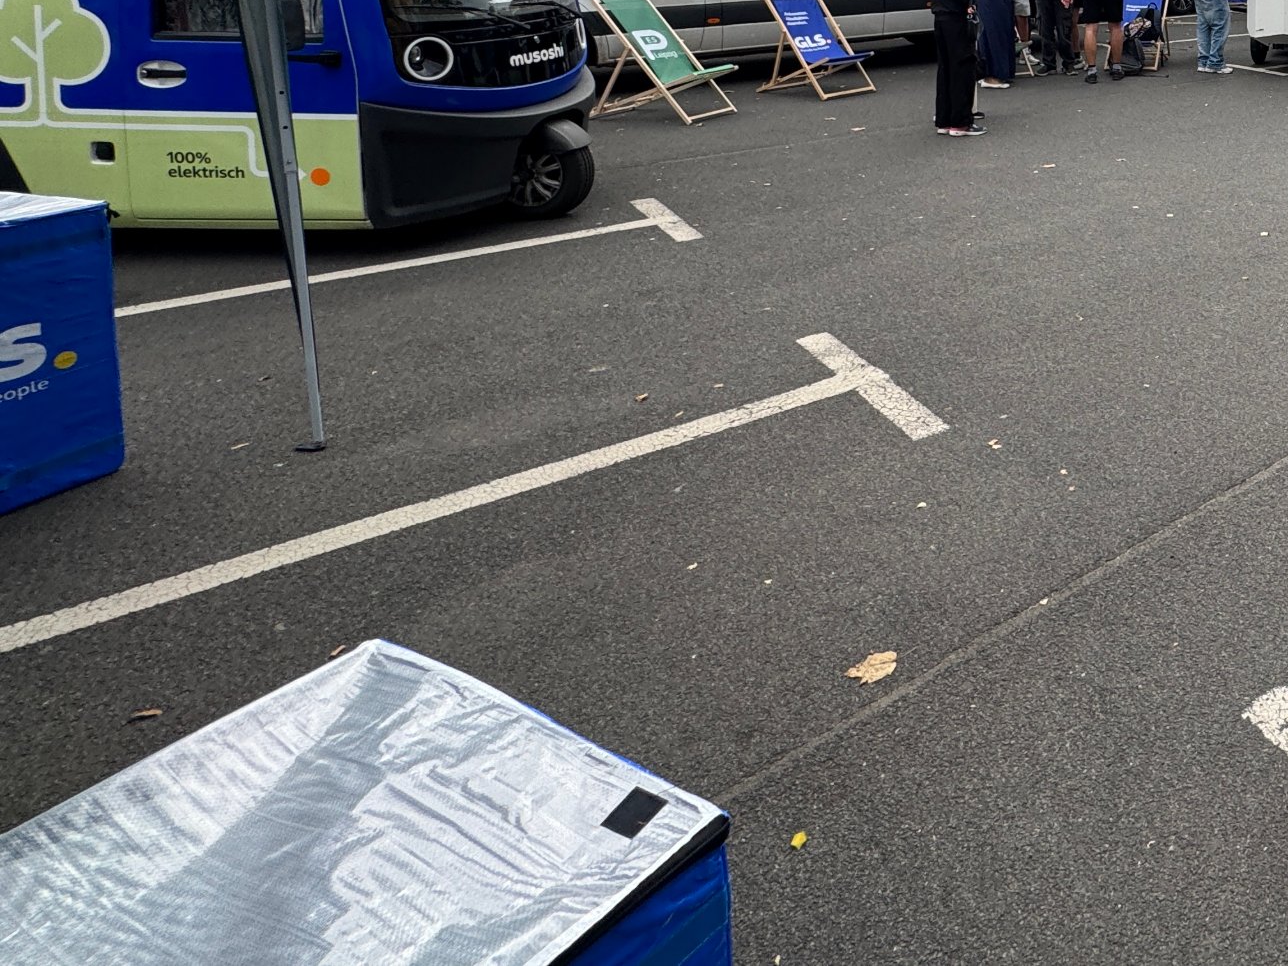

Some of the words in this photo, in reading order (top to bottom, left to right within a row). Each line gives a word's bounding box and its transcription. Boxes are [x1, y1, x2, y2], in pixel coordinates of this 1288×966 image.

[509, 42, 565, 67] musoshi
[166, 151, 212, 164] 100%
[168, 166, 245, 179] elektrisch
